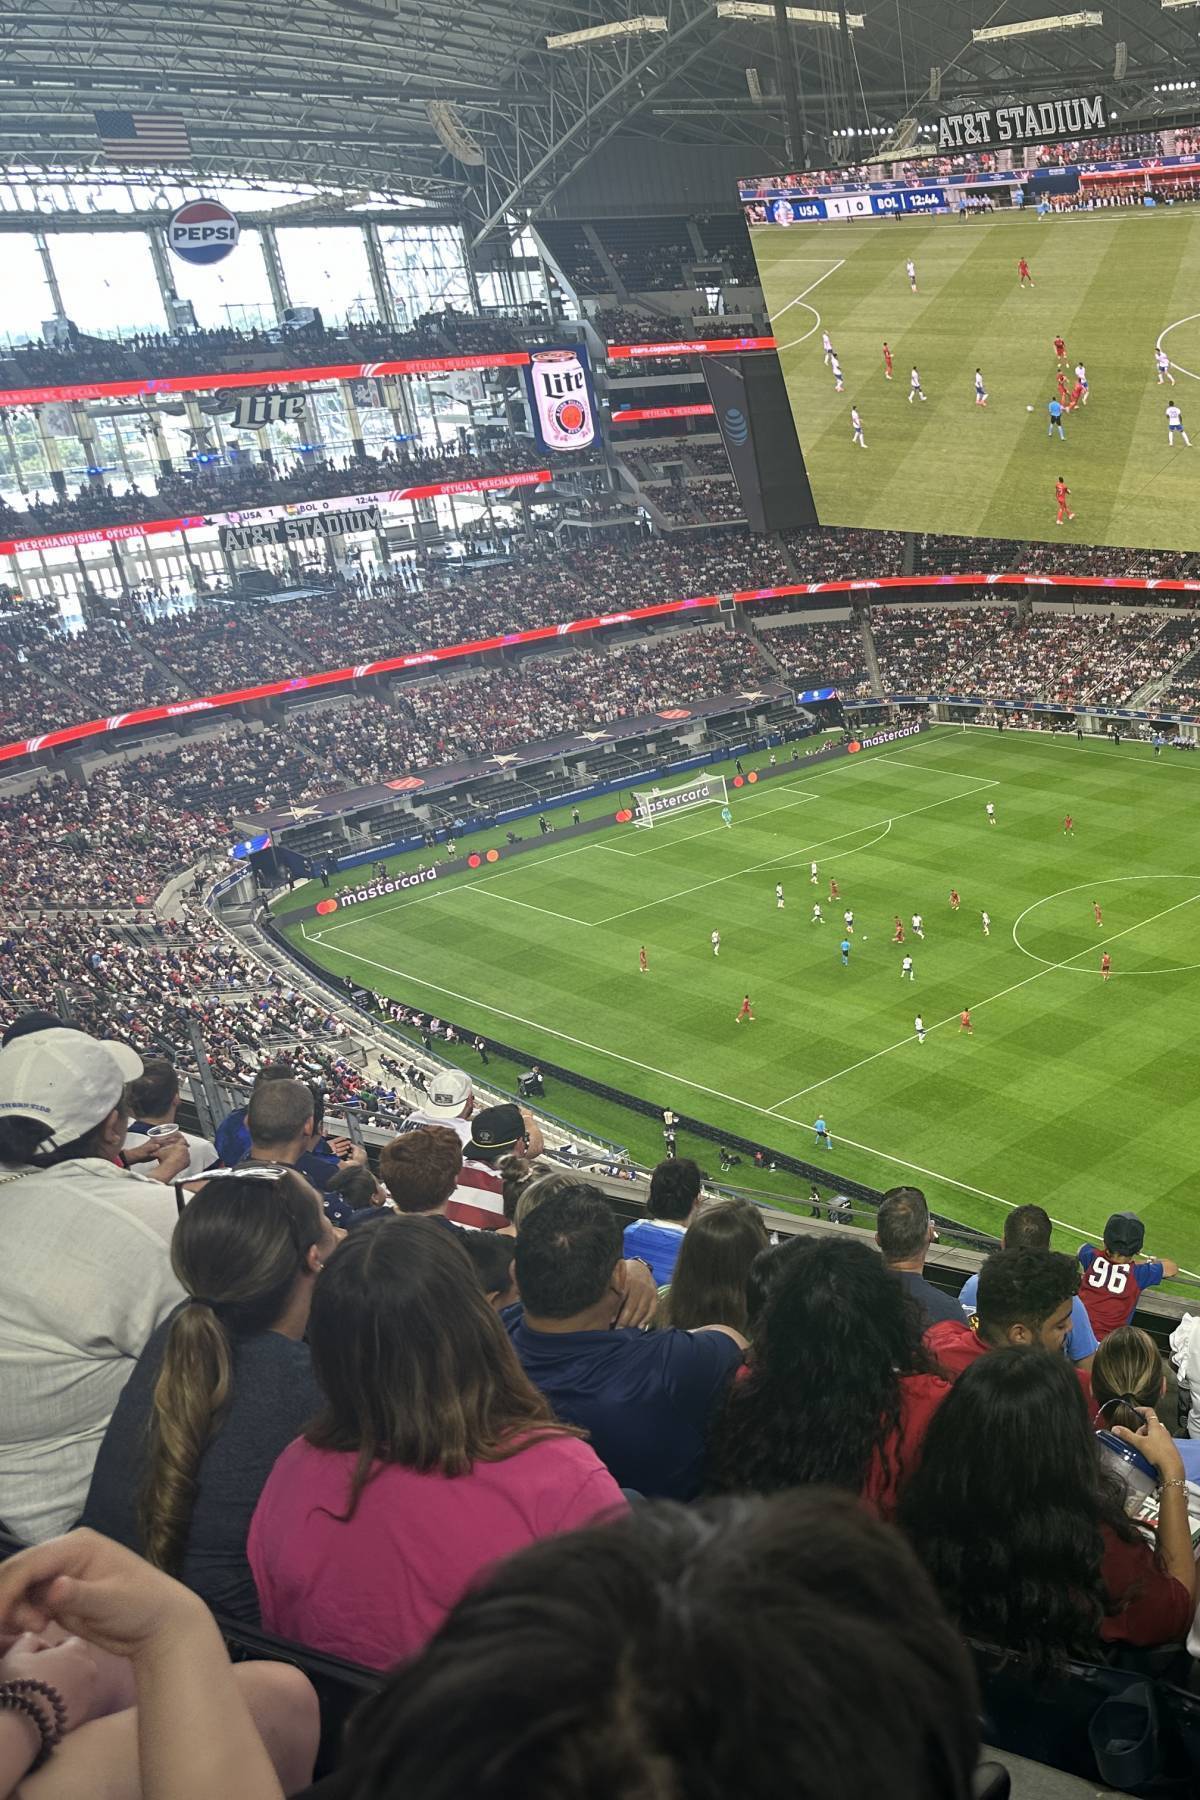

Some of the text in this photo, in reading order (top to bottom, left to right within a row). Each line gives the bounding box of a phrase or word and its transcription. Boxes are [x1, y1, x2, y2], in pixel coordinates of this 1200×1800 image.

[937, 96, 1106, 148] AT&T STADIUM
[799, 193, 940, 217] USA 1 0 BOL 12:44
[173, 226, 236, 241] PEPSI
[541, 371, 584, 399] Lite
[231, 391, 307, 430] Lite
[441, 473, 541, 493] OFFICIAL MERCHANDISING
[242, 511, 263, 520] USA
[299, 504, 318, 513] BOL
[322, 502, 330, 510] 0
[14, 526, 149, 551] MERCHANDISING OFICIAL
[225, 510, 384, 551] AT&T STADIUM
[862, 723, 920, 749] mastercard
[635, 785, 711, 816] mastercard
[341, 867, 437, 907] mastercard
[1088, 1256, 1131, 1294] 96
